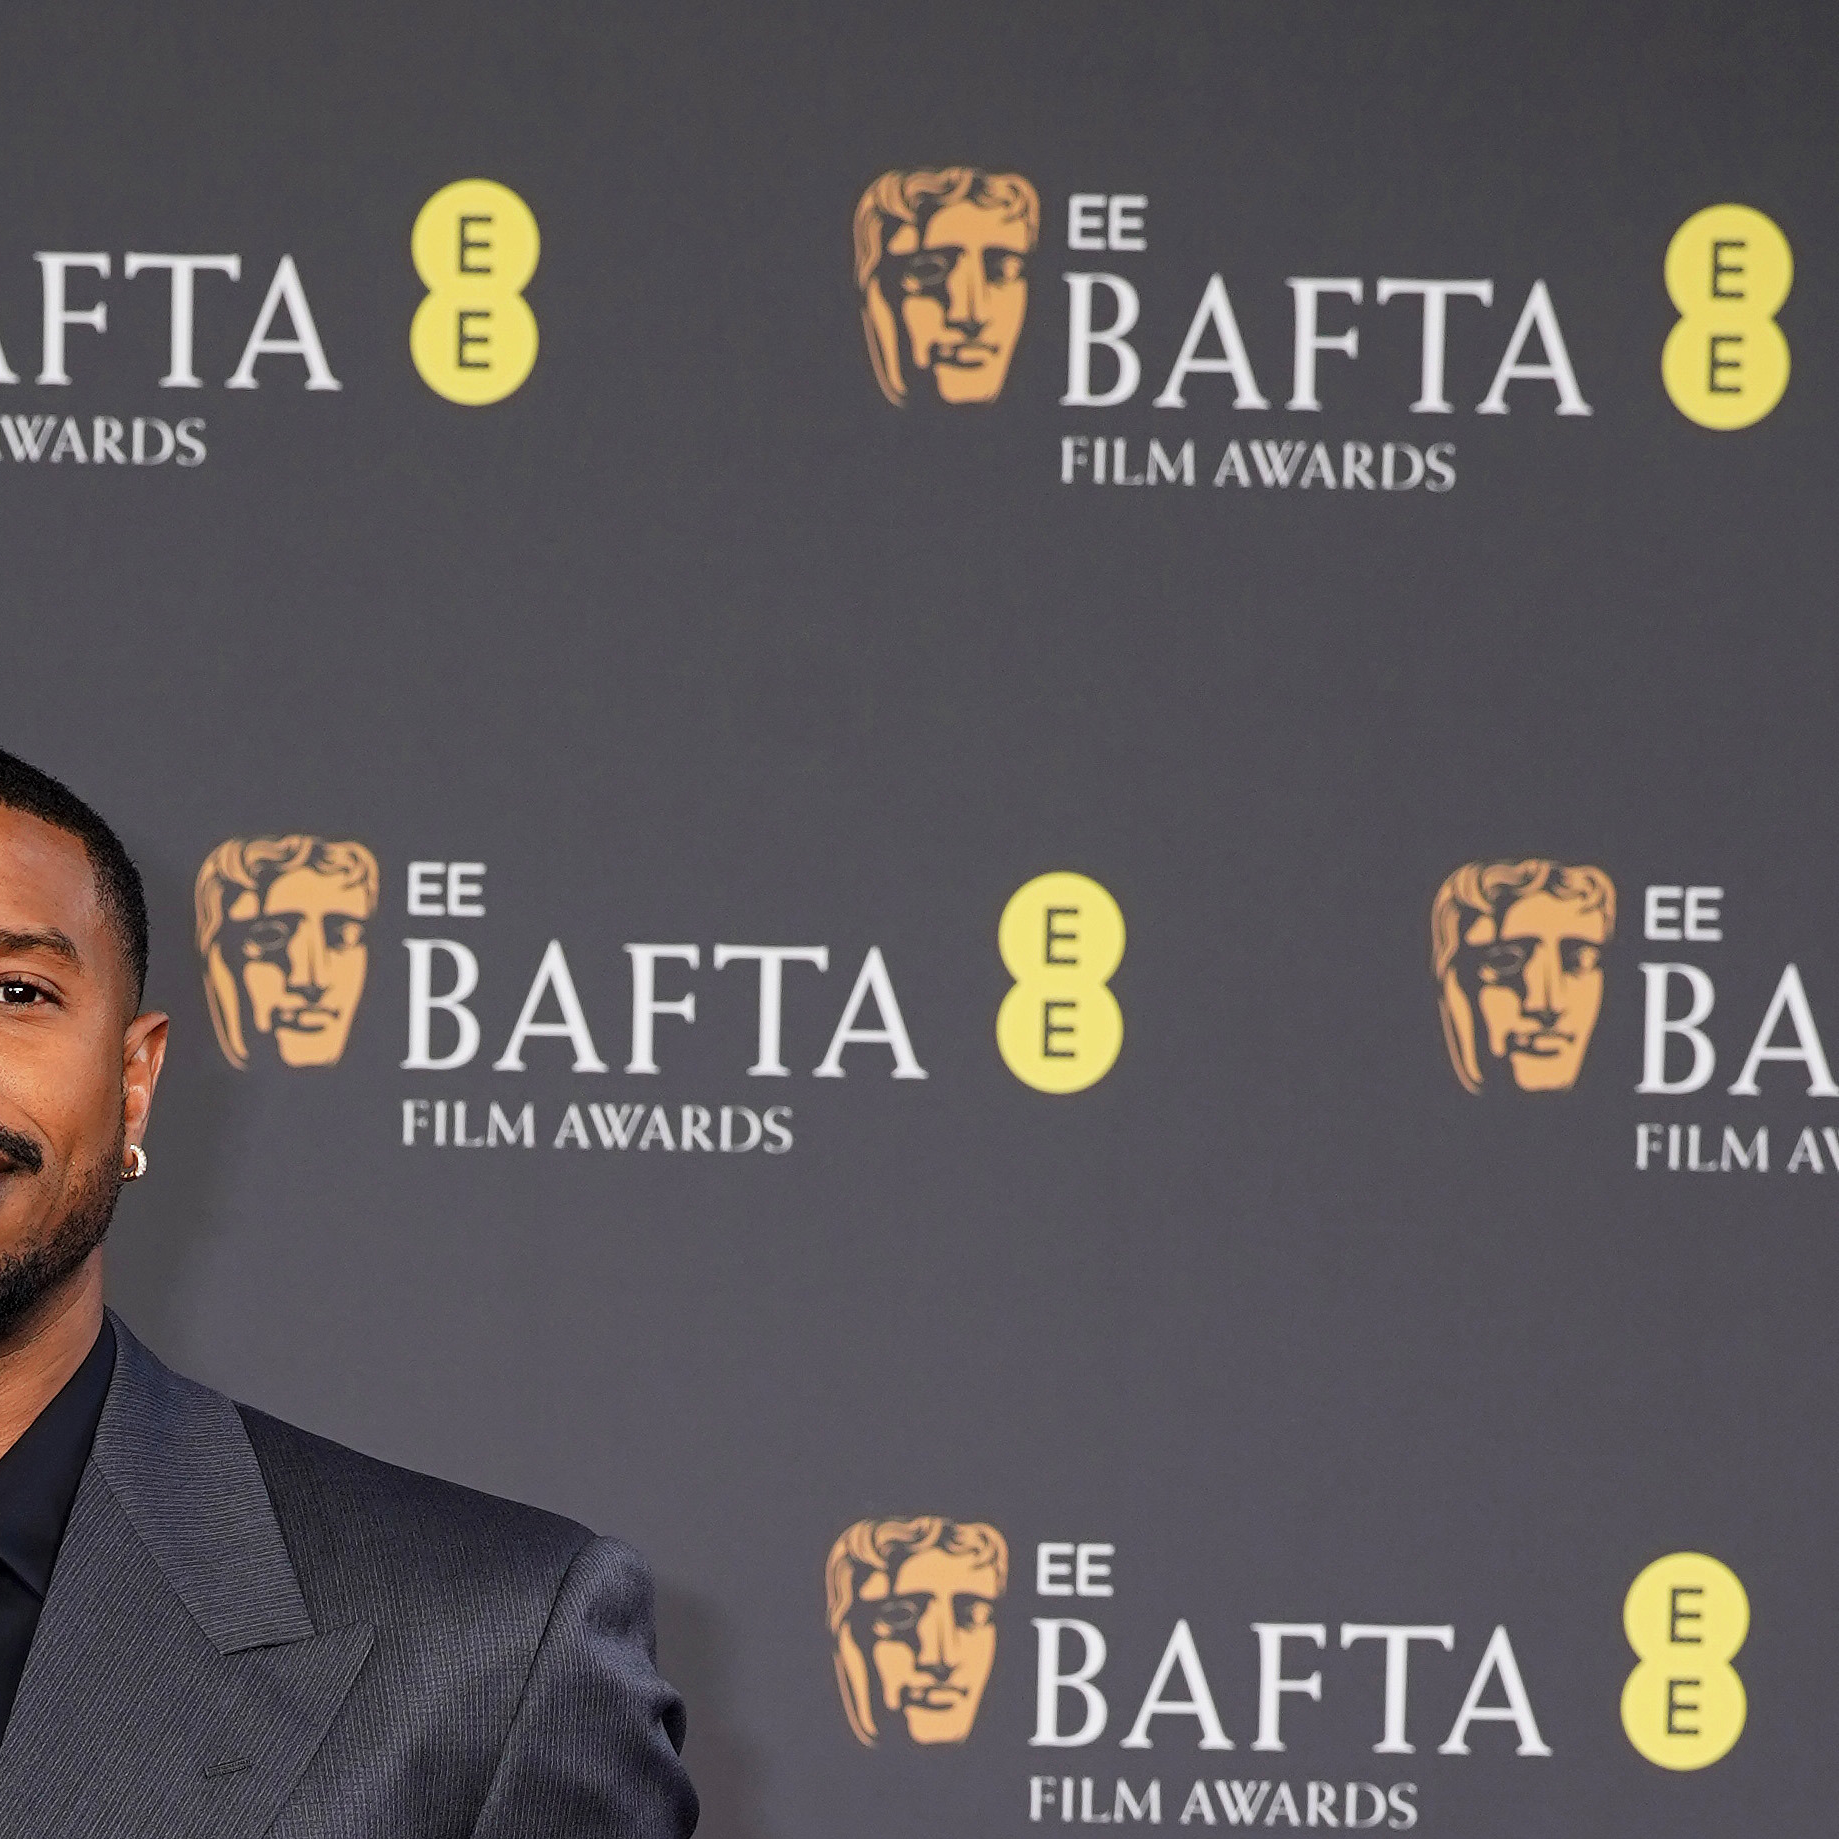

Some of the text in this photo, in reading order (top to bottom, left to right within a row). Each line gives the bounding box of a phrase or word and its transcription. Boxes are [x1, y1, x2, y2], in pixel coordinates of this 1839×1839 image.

[1068, 194, 1148, 251] EE
[1061, 272, 1592, 416] BAFTA
[1062, 437, 1455, 491] FILM AWARDS
[407, 861, 486, 917] EE
[1644, 885, 1724, 941] EE
[400, 938, 929, 1079] BAFTA
[403, 1099, 793, 1153] FILM AWARDS
[1636, 1124, 1768, 1172] FILM
[1037, 1542, 1115, 1597] EE
[1028, 1618, 1553, 1756] BAFTA
[1029, 1776, 1417, 1829] FILM AWARDS
